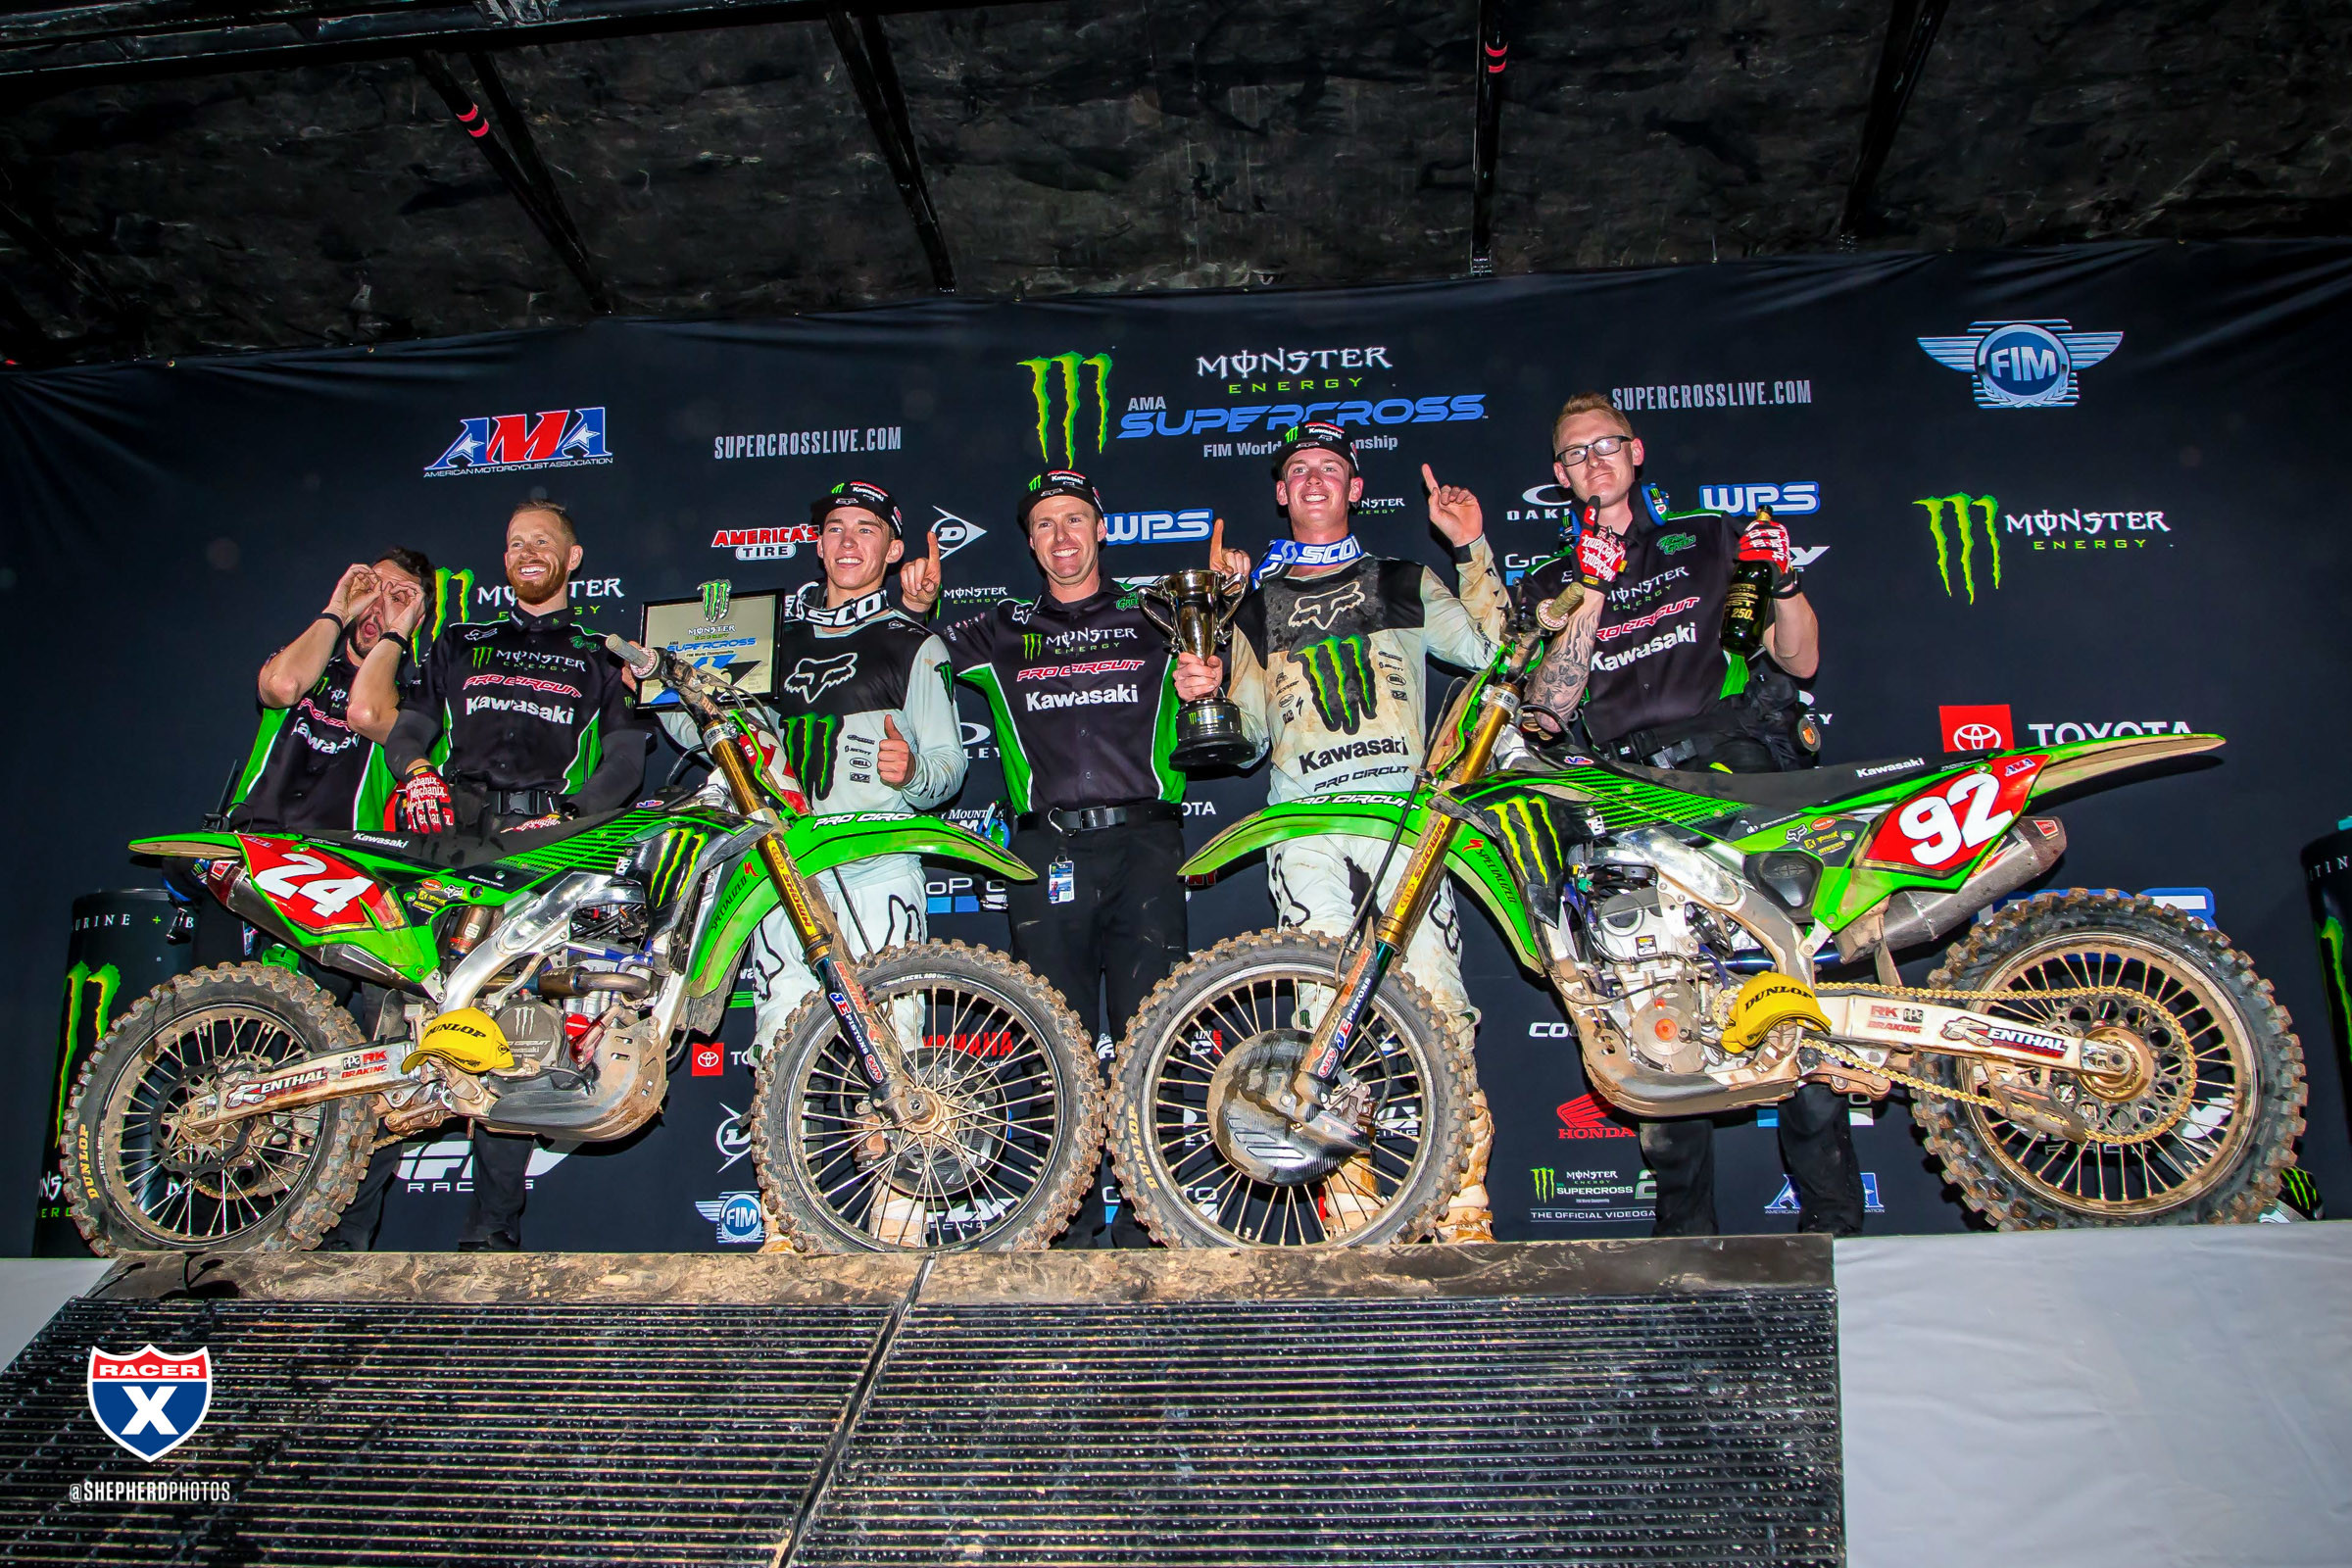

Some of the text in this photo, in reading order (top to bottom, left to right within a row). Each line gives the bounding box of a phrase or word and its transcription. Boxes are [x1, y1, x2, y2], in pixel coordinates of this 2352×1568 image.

[1197, 346, 1394, 379] MONSTER
[1989, 346, 2057, 382] FIM
[1228, 376, 1363, 394] ENERGY
[1612, 379, 1812, 411] SUPERCROSSLIVE.COM
[1116, 394, 1487, 438] SUPERCROSS
[1128, 396, 1166, 412] AMA
[423, 407, 612, 470] AMA
[714, 426, 902, 460] SUPERCROSSLIVE.COM
[1203, 441, 1282, 458] FIM World
[423, 458, 613, 478] AMERICAN MOTORCYCLIST ASSOCIATION
[1052, 475, 1083, 485] Kawasaki
[853, 486, 884, 502] Kawasaki
[1702, 484, 1817, 514] WPS
[1106, 512, 1210, 541] WPS
[1506, 509, 1571, 521] OAK
[2004, 508, 2172, 537] MONSTER
[710, 523, 820, 548] AMERICA'S
[2033, 539, 2147, 551] ENERGY
[742, 546, 789, 558] TIRE
[1297, 535, 1364, 564] SCO
[477, 577, 625, 607] MOTER
[944, 586, 1007, 599] MONSTER
[1613, 584, 1672, 612] ENERGY
[805, 592, 887, 627] SCO
[1115, 598, 1139, 611] GREE
[688, 624, 736, 636] MONSTER
[1595, 596, 1700, 642] RO CIRCUIT
[666, 637, 757, 653] SUPERCROSS
[1046, 627, 1139, 647] MONSTER
[1054, 642, 1120, 655] ENERGY
[1590, 622, 1696, 671] Kawasaki
[496, 649, 587, 672] MONSTER
[503, 661, 568, 672] ENERGY
[1016, 660, 1146, 681] PRO CIRCUIT
[463, 673, 582, 698] PRO CIRCUIT
[1025, 684, 1139, 711] Kawasaki
[466, 696, 574, 725] Kawasaki
[1298, 736, 1409, 775] Kawasaki
[1620, 746, 1631, 755] 92
[1313, 764, 1410, 792] PRO CIRCUIT
[1855, 757, 1925, 779] Kawasaki
[2004, 758, 2035, 777] AMA
[411, 785, 445, 799] Mechanix
[1332, 794, 1422, 810] CIRCUIT
[1182, 802, 1216, 816] OTA
[1898, 772, 2015, 866] 92
[812, 812, 854, 831] PRO
[353, 833, 409, 849] Kawasaki
[1414, 820, 1446, 880] SHOWA
[253, 854, 374, 918] 24
[1475, 848, 1517, 905] SPECIALIZED
[710, 875, 747, 933] SPECIALIZED
[782, 873, 812, 927] SHOWA
[834, 961, 867, 1013] BRAKING
[1744, 985, 1813, 1012] DUNLOP
[828, 992, 869, 1054] JE PISTONS
[1335, 977, 1371, 1051] JE PISTONS
[1870, 1004, 1924, 1023] RK PPG
[424, 1022, 487, 1040] DUNLOP
[1866, 1020, 1922, 1034] BRAKING
[922, 1032, 1013, 1056] YAMAHA
[341, 1063, 390, 1079] BRAKING
[343, 1050, 389, 1070] PPG RK
[866, 1054, 883, 1081] GUTS
[1318, 1049, 1337, 1077] GUTS
[1128, 1102, 1159, 1190] DUNLOP
[1558, 1128, 1637, 1140] HONDA
[78, 1123, 100, 1200] DUNLOP
[1566, 1170, 1619, 1180] MONSTER
[1556, 1186, 1634, 1195] SUPERCROSS
[726, 1206, 758, 1227] FIM
